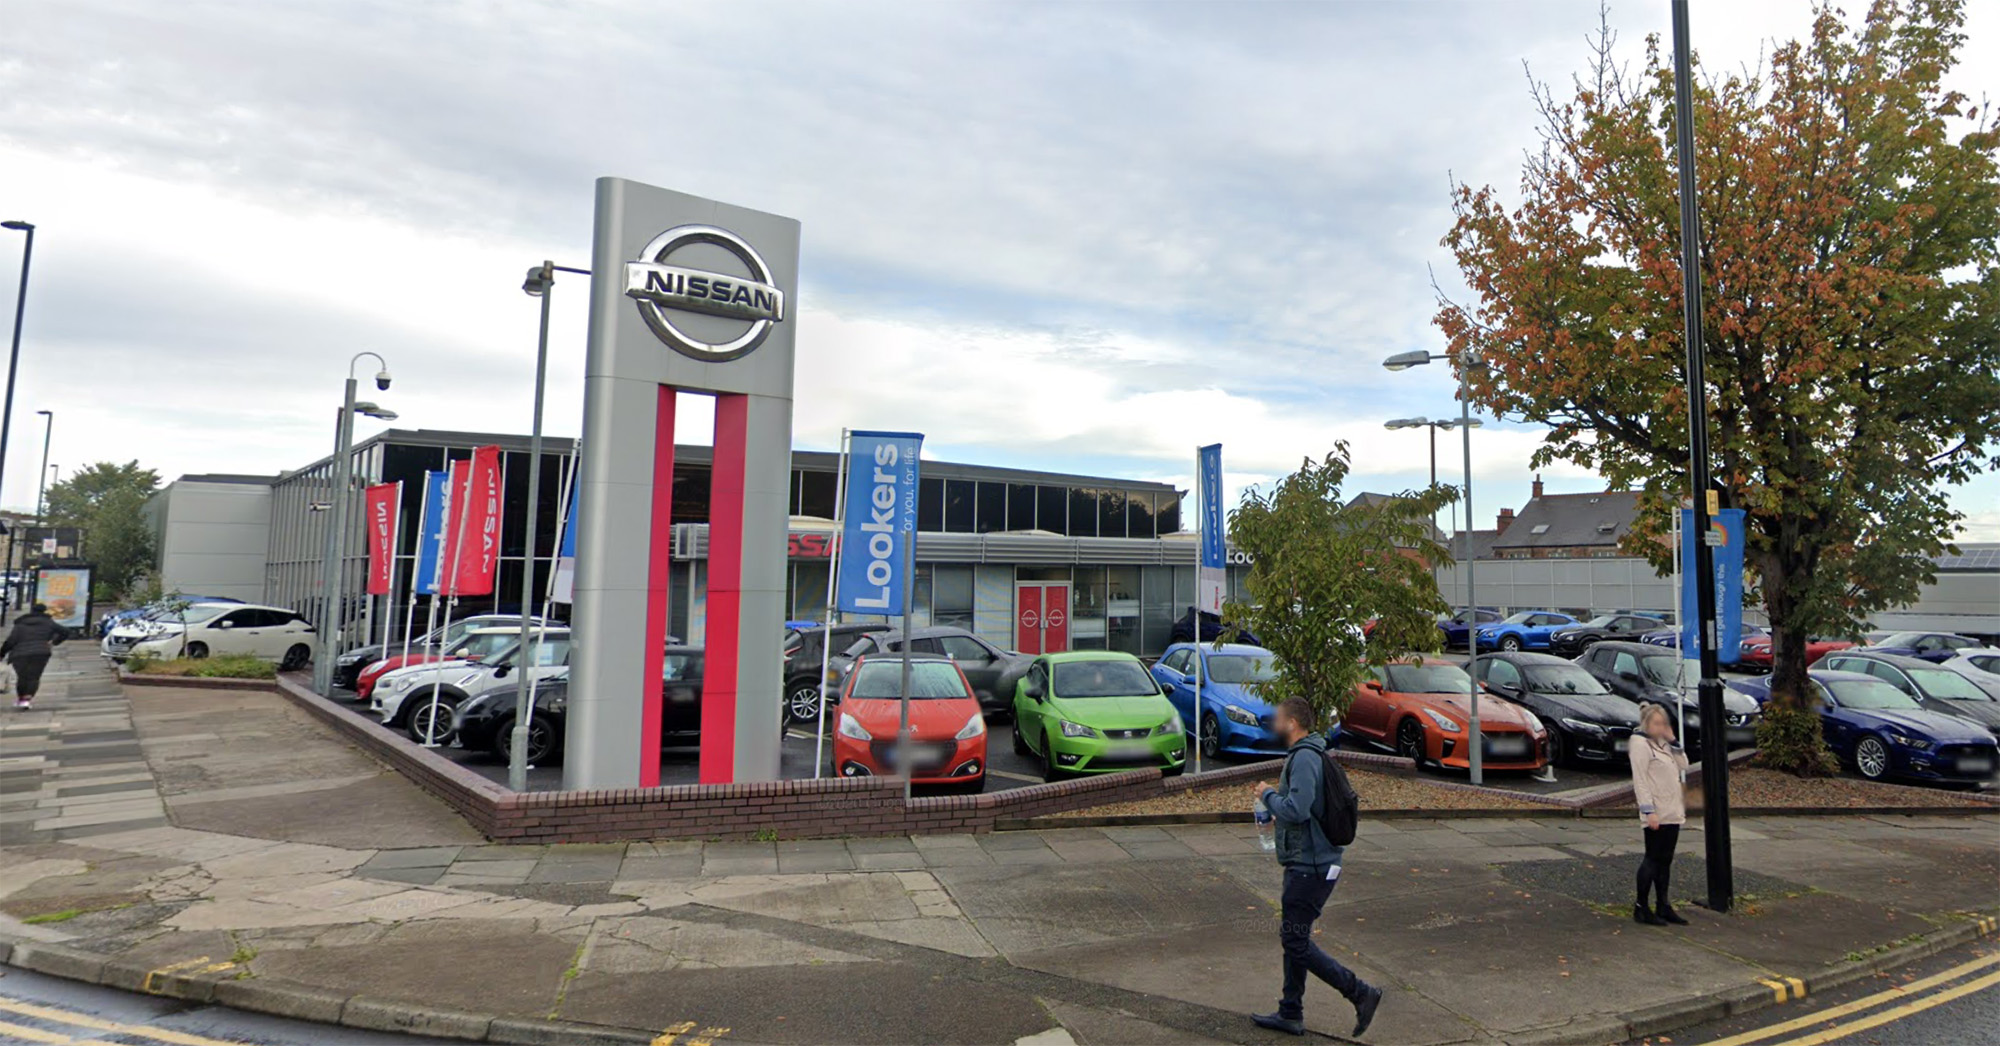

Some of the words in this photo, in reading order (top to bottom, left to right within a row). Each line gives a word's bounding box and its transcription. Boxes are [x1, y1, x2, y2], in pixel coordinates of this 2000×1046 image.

[645, 270, 773, 311] NISSAN
[903, 446, 915, 465] life
[902, 468, 914, 485] for
[481, 468, 497, 574] NISSAN
[854, 443, 898, 609] Lookers
